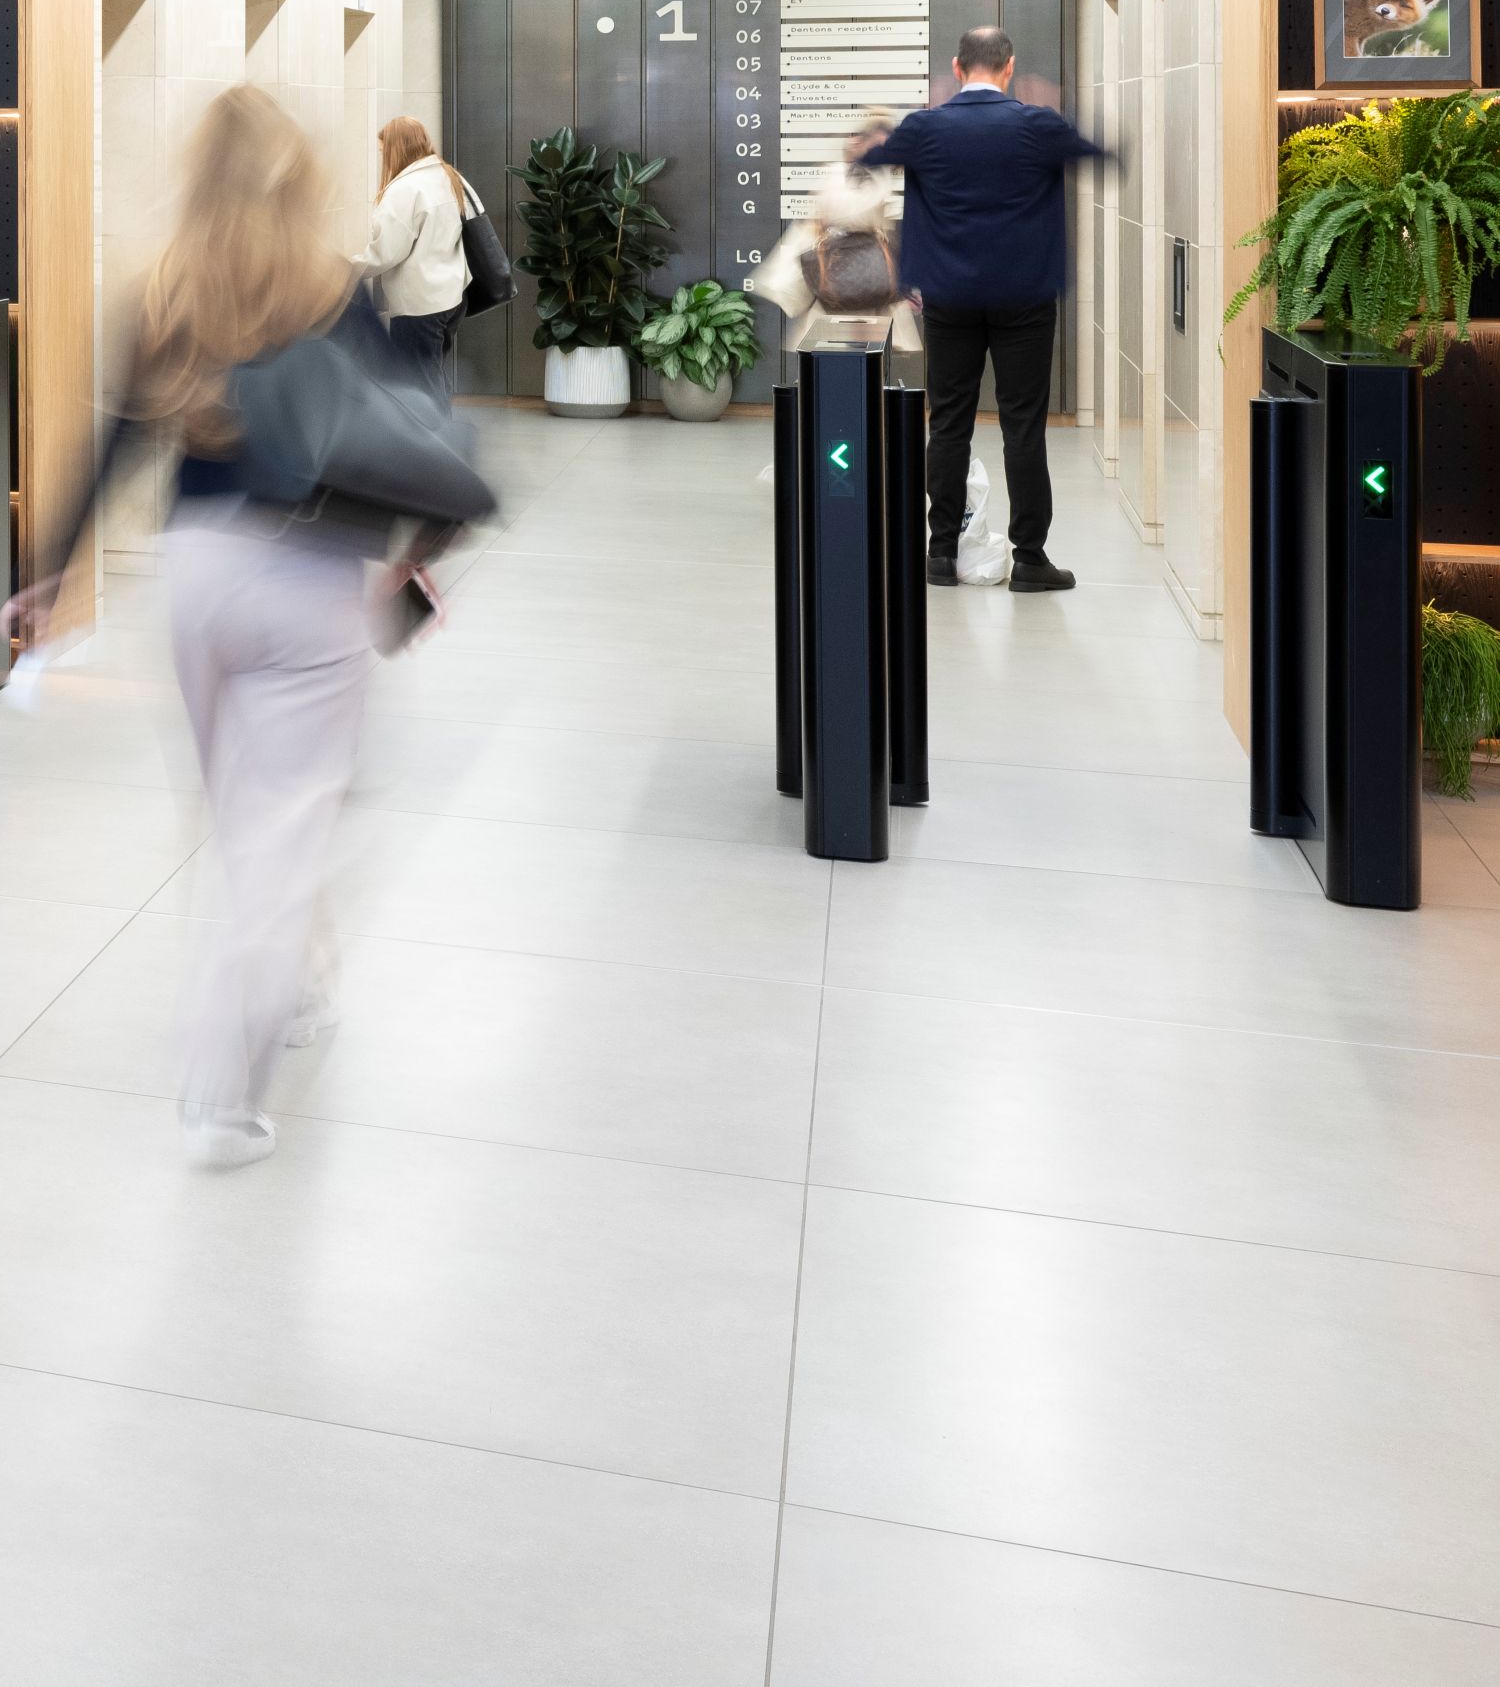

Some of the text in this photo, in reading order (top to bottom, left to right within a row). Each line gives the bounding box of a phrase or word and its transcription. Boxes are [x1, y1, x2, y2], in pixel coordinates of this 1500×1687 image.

[735, 0, 762, 15] 07
[655, 0, 698, 42] 1
[837, 25, 892, 33] reception
[735, 29, 762, 44] 06
[736, 57, 762, 72] 05
[735, 86, 762, 101] 04
[736, 114, 762, 129] 03
[735, 143, 762, 157] 02
[737, 171, 761, 185] 01
[742, 200, 757, 214] G
[736, 250, 762, 263] LG
[743, 278, 755, 292] B
